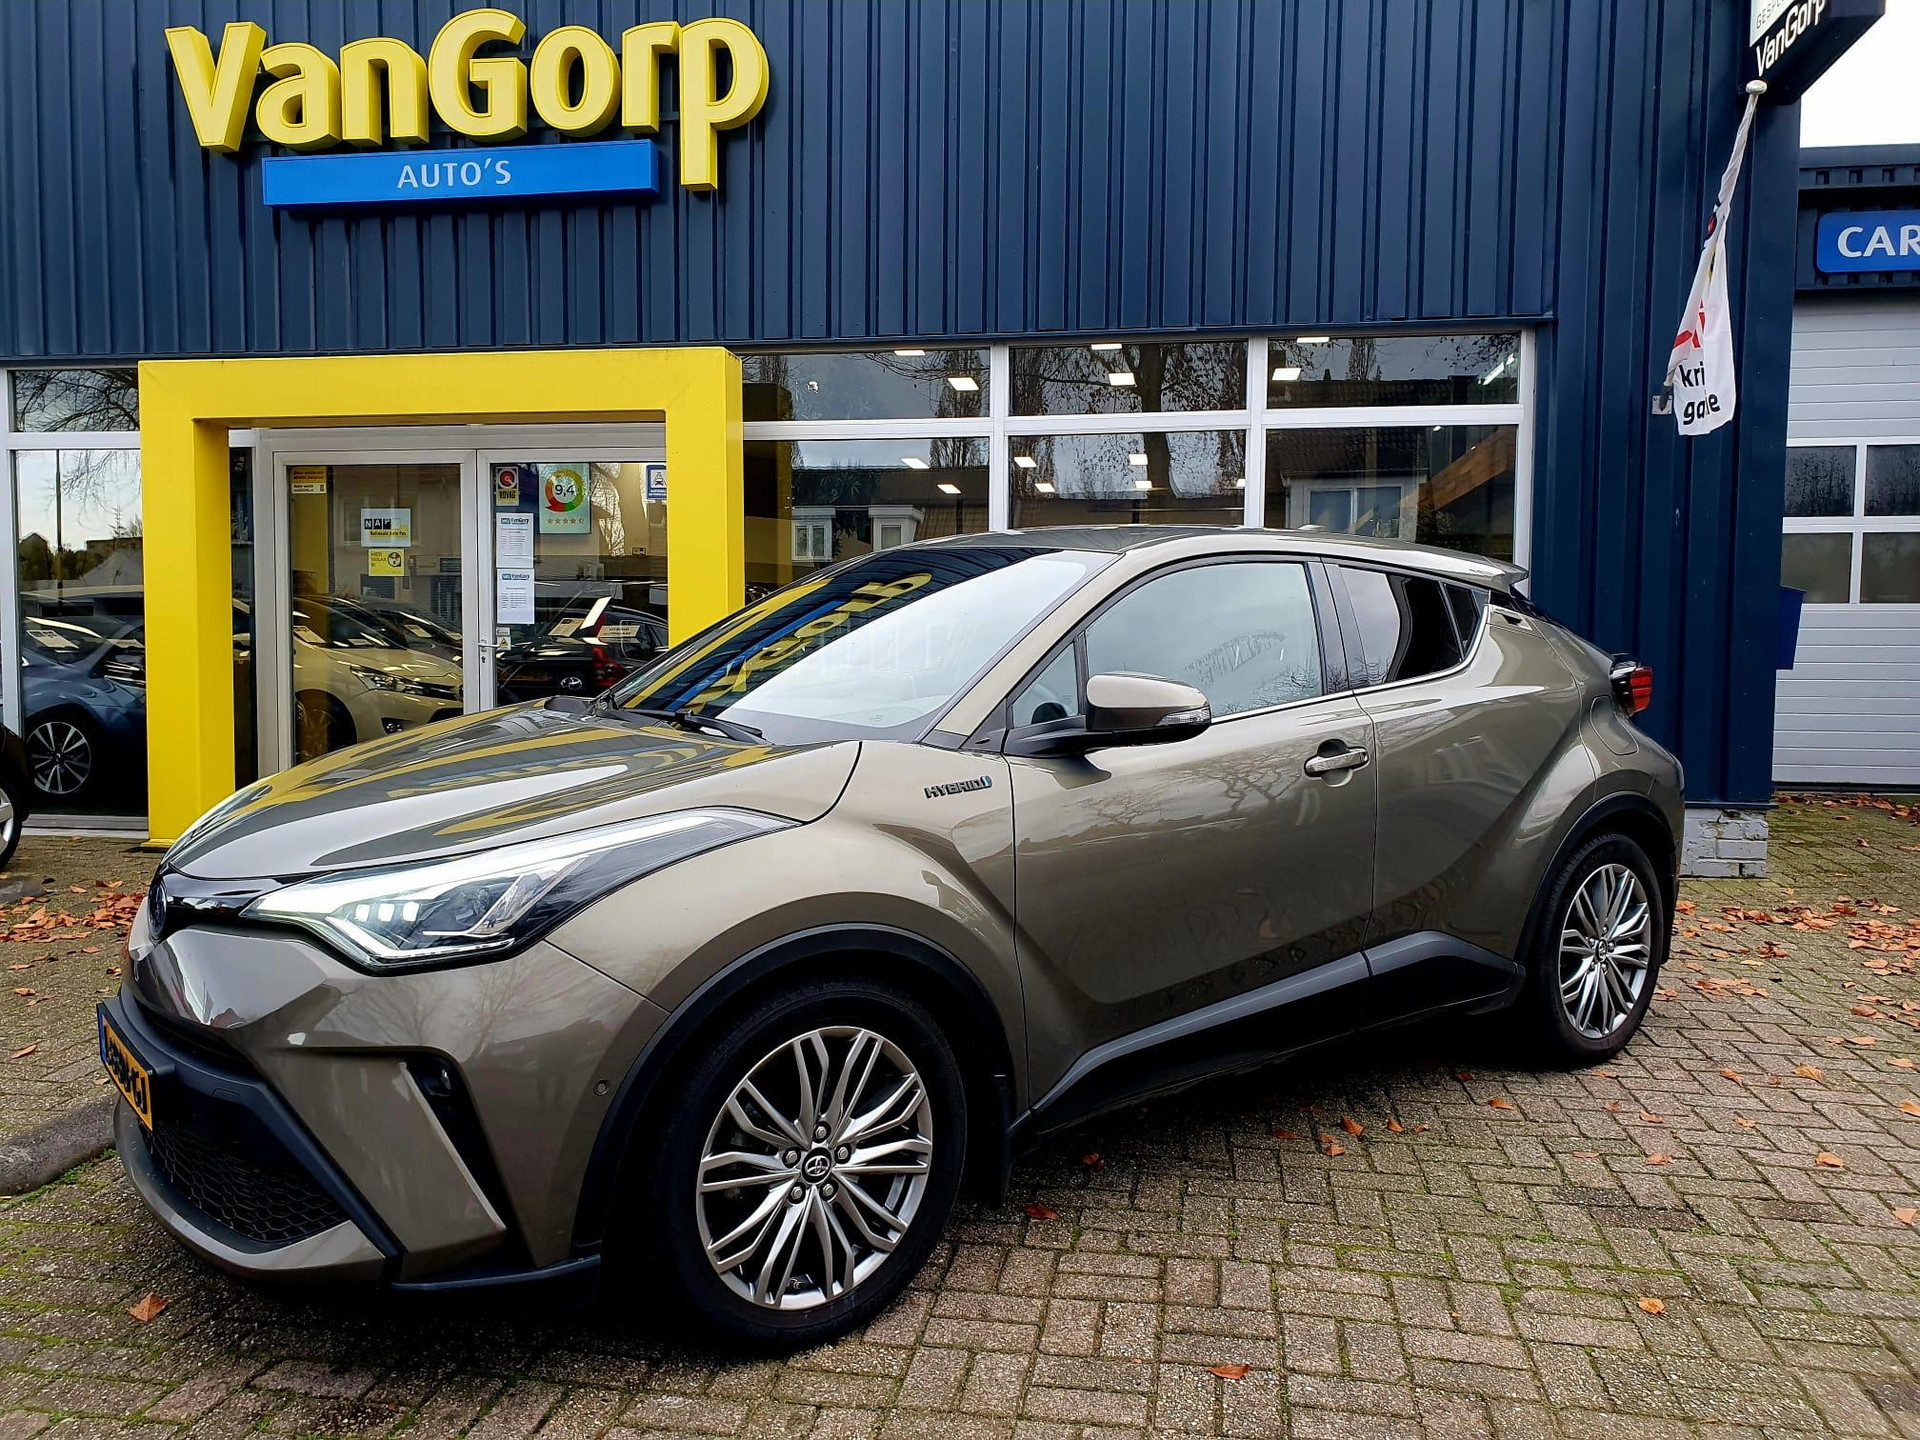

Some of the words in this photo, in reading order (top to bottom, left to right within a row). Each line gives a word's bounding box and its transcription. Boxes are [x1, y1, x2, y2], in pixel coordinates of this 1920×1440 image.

[1756, 0, 1826, 77] VanGorp
[164, 8, 770, 191] VanGorp
[396, 157, 512, 189] AUTO'S
[1837, 224, 1920, 258] CAR
[554, 484, 576, 497] 9,4
[924, 777, 984, 798] HYBRID
